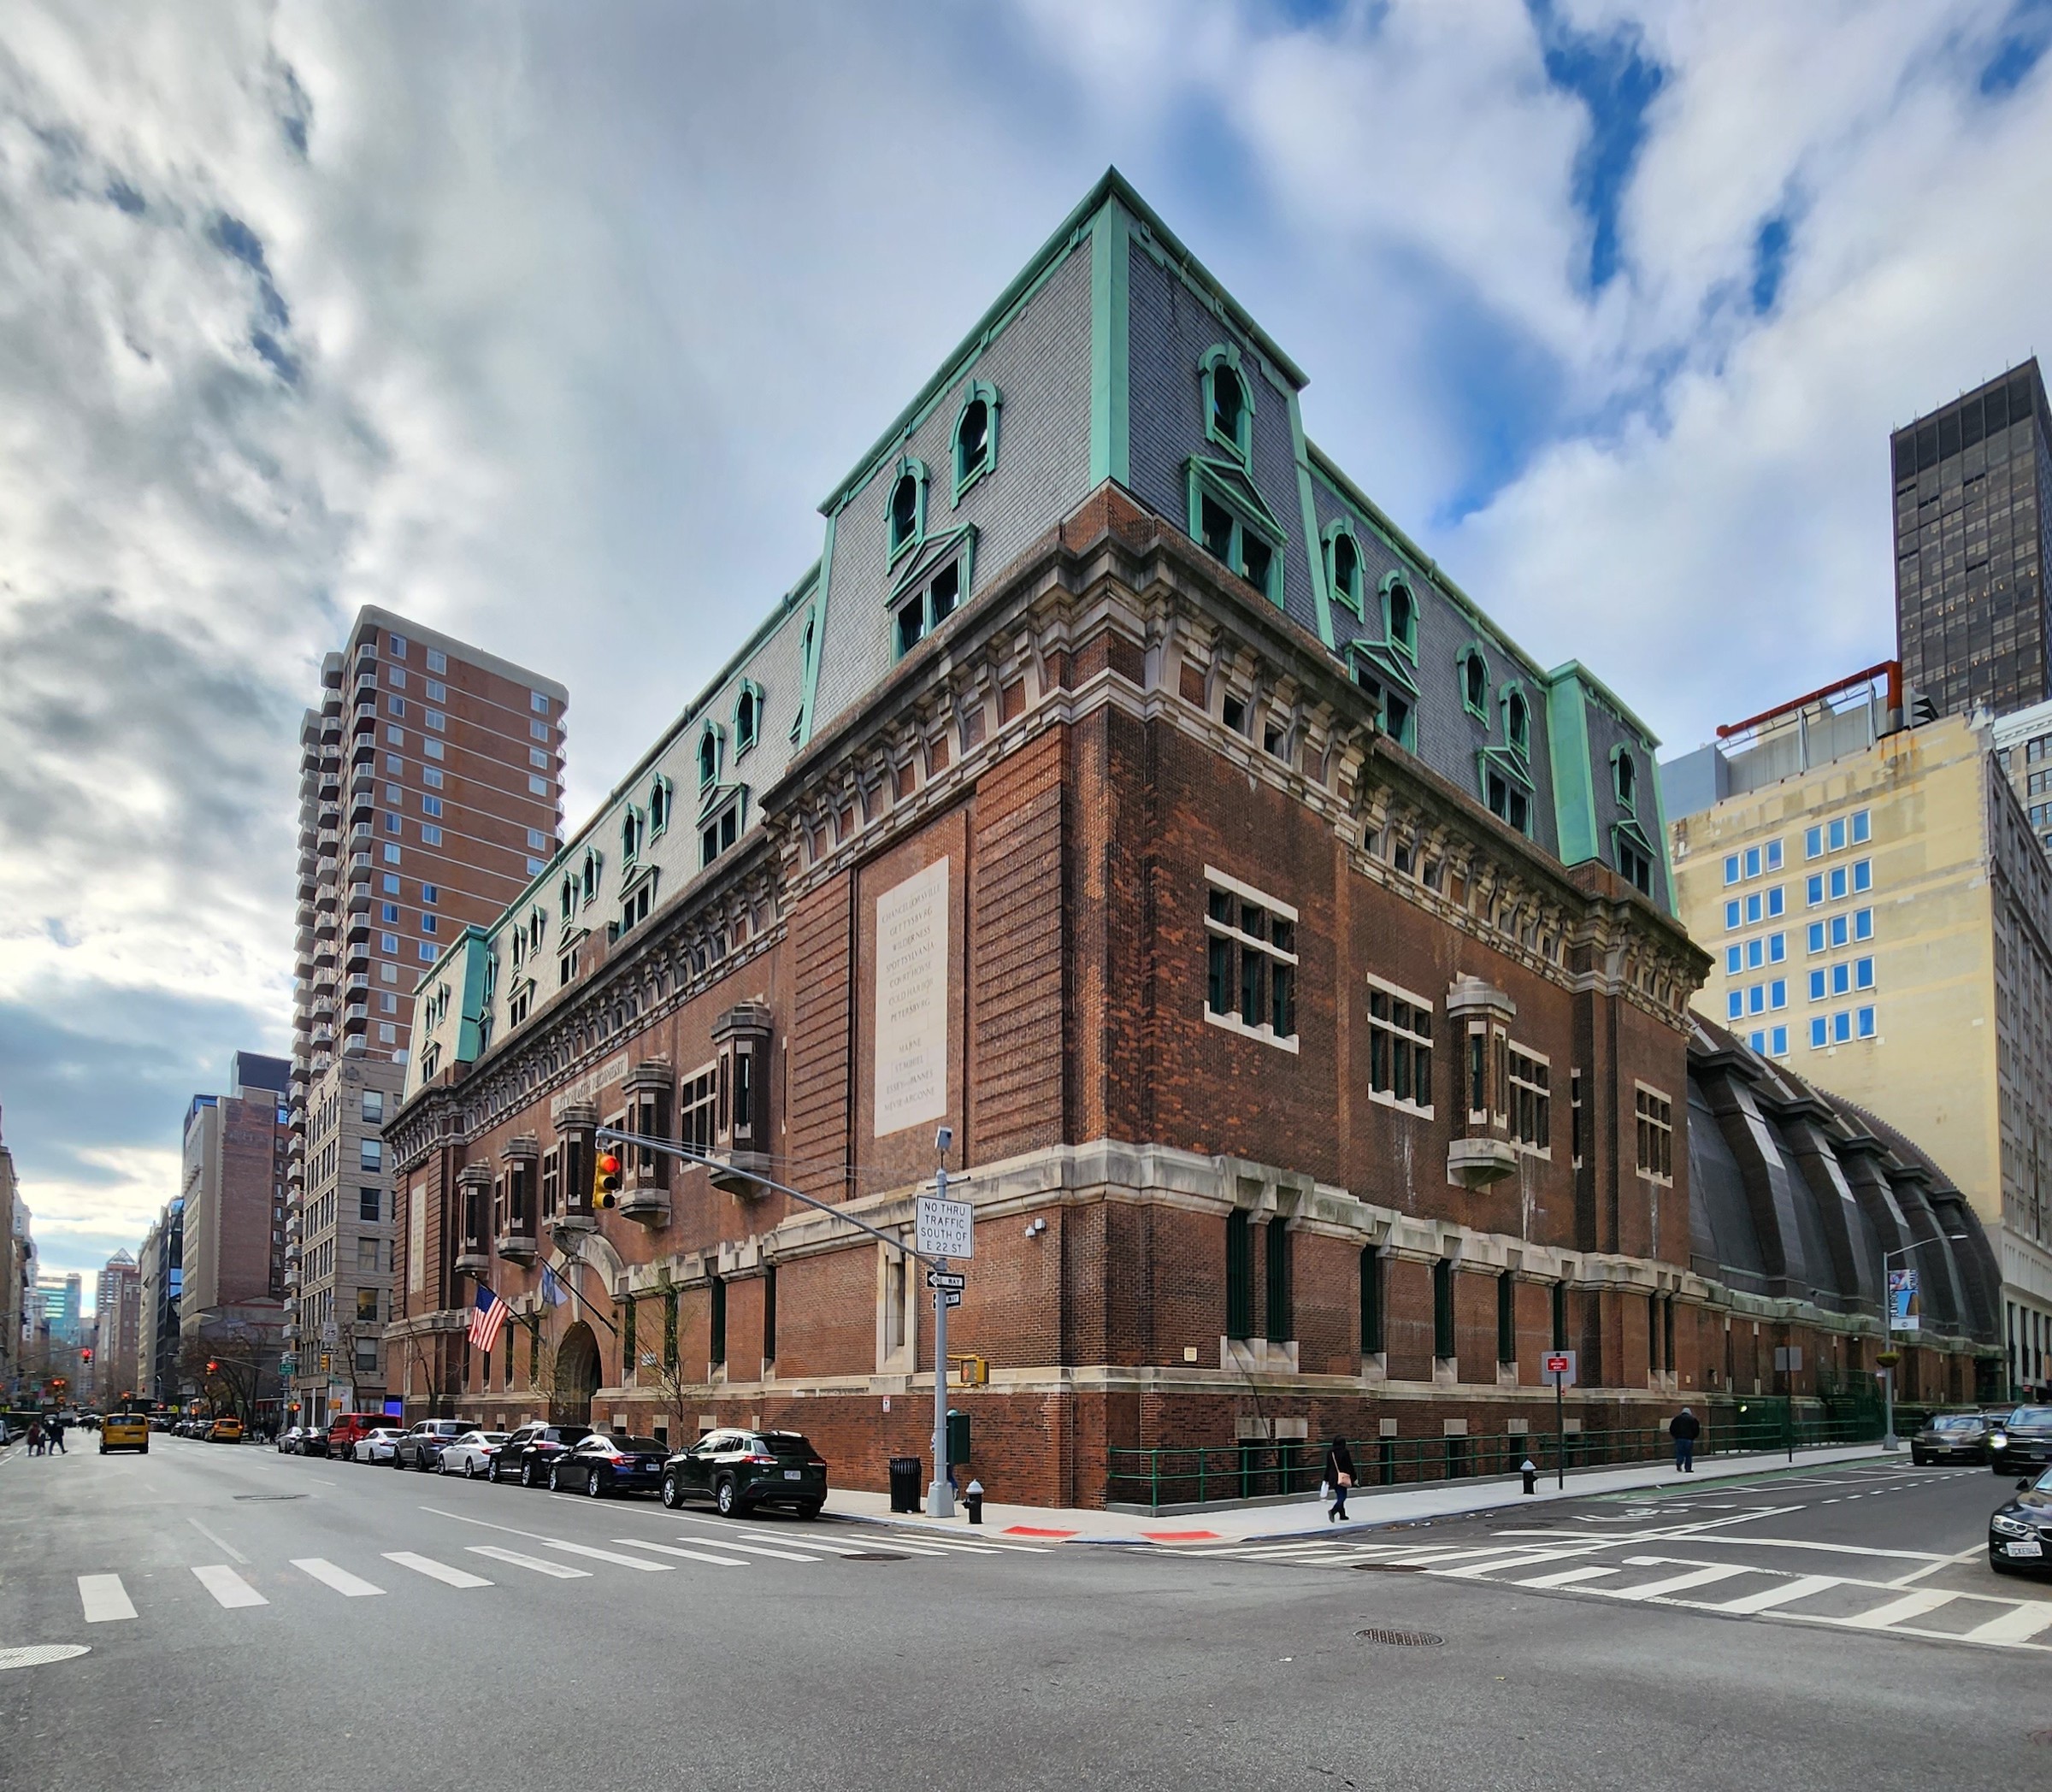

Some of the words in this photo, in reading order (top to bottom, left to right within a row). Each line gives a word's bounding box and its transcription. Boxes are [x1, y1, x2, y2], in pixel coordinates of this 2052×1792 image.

[893, 925, 931, 952] WILDERNESS
[886, 941, 935, 973] SPOTTSYLVANIA
[888, 991, 906, 1006] COLD
[899, 1037, 922, 1052] MARNE
[924, 1201, 937, 1212] NO
[941, 1204, 966, 1217] THRU
[925, 1214, 964, 1229] TRAFFIC
[921, 1227, 952, 1241] SOUTH
[956, 1231, 968, 1241] OF
[927, 1241, 932, 1250] E
[936, 1241, 948, 1252] 22
[952, 1243, 962, 1253] ST
[932, 1276, 943, 1285] ONE
[947, 1277, 961, 1286] WAY
[947, 1294, 958, 1304] WAY
